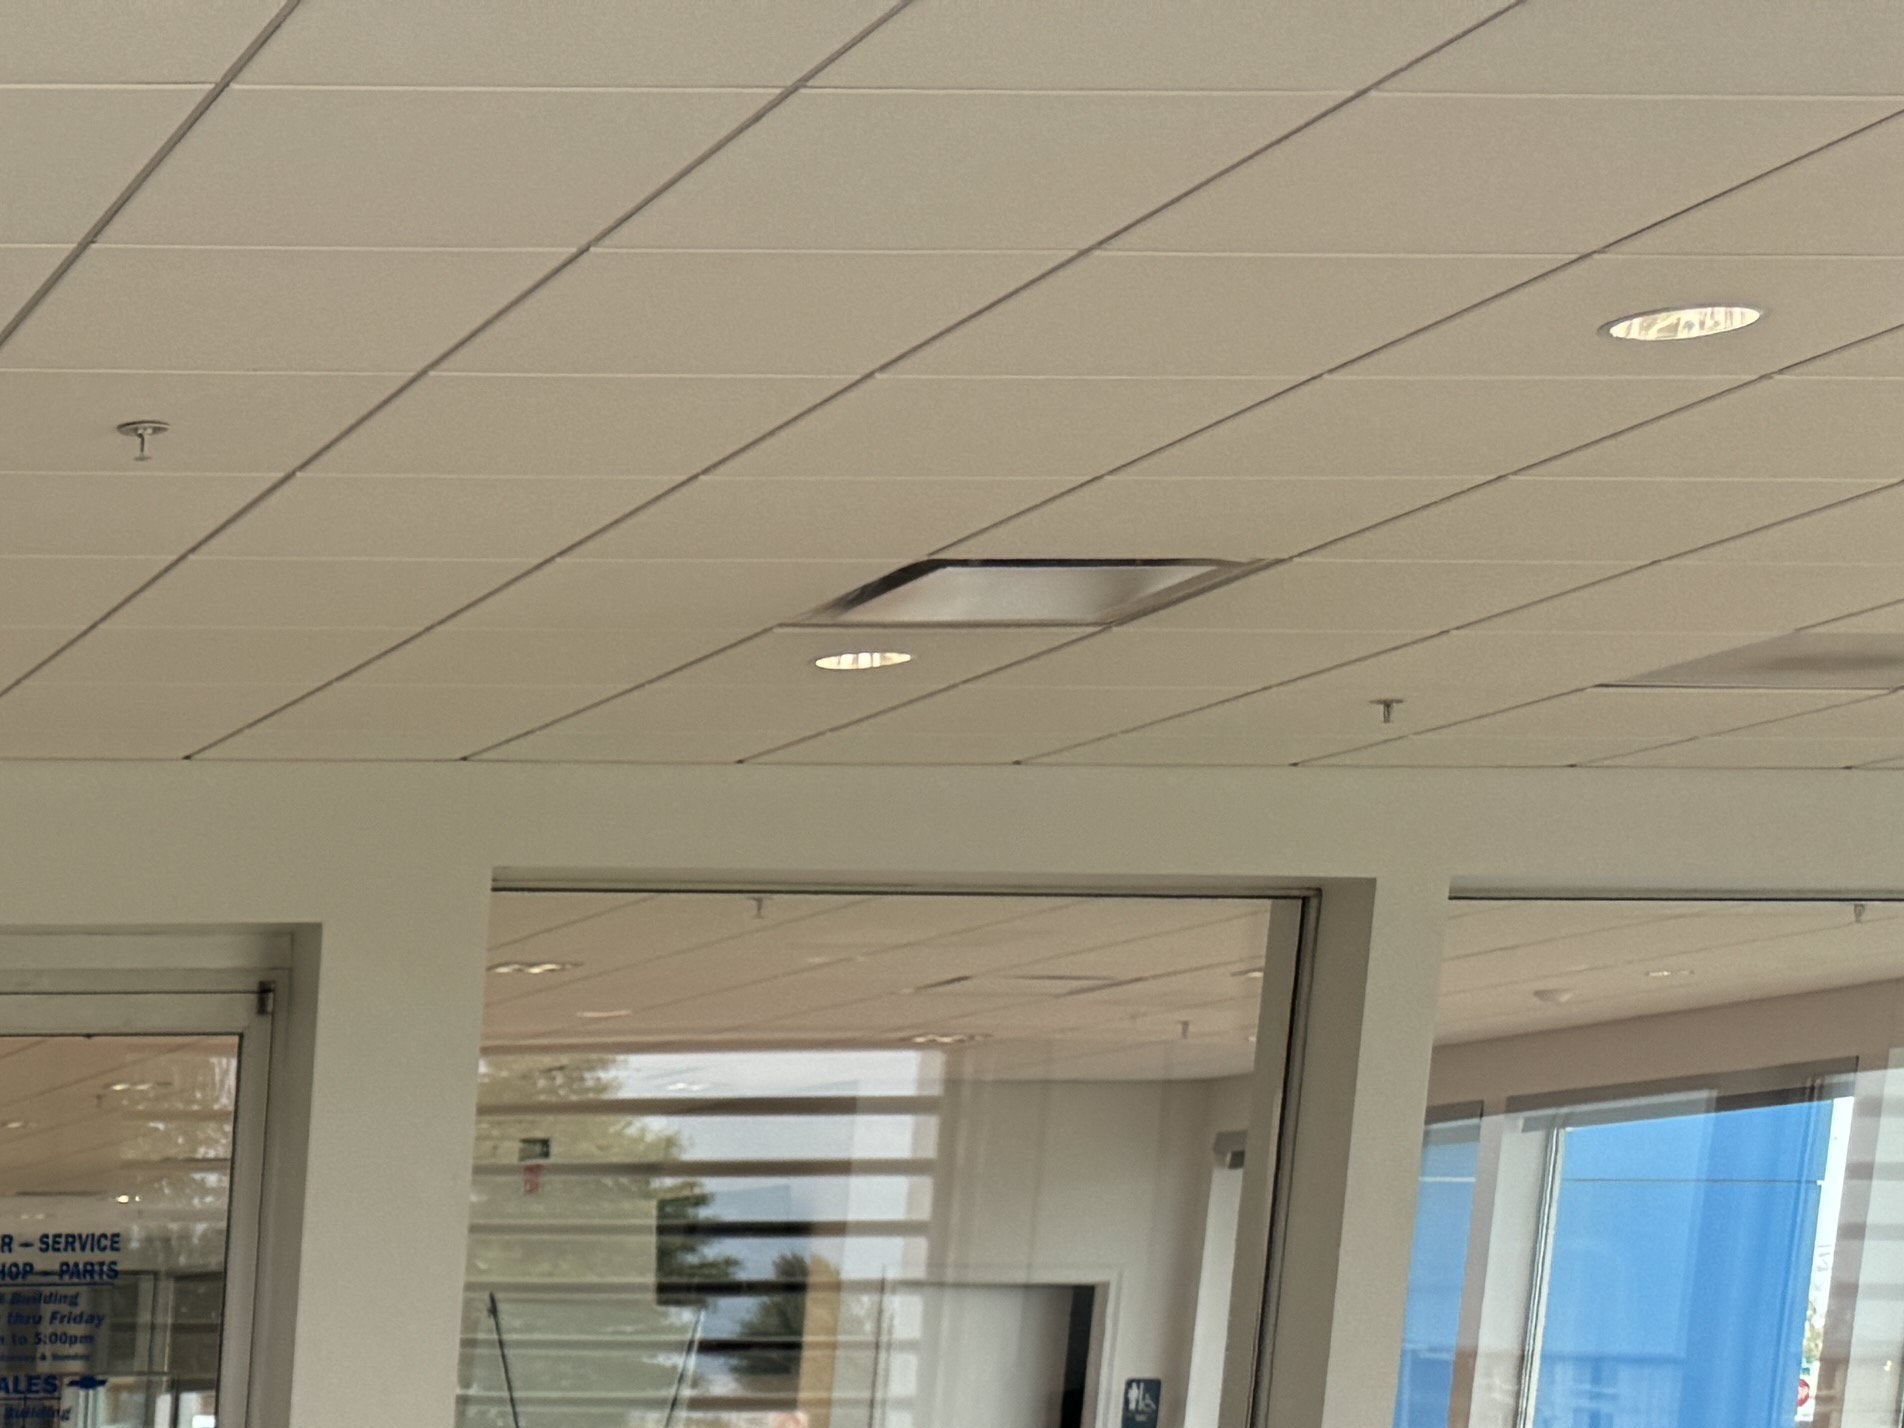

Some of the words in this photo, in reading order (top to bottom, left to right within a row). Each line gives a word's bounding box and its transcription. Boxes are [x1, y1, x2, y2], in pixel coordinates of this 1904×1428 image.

[38, 1232, 122, 1253] SERVICE
[59, 1261, 120, 1281] PARTS
[49, 1311, 106, 1328] Friday
